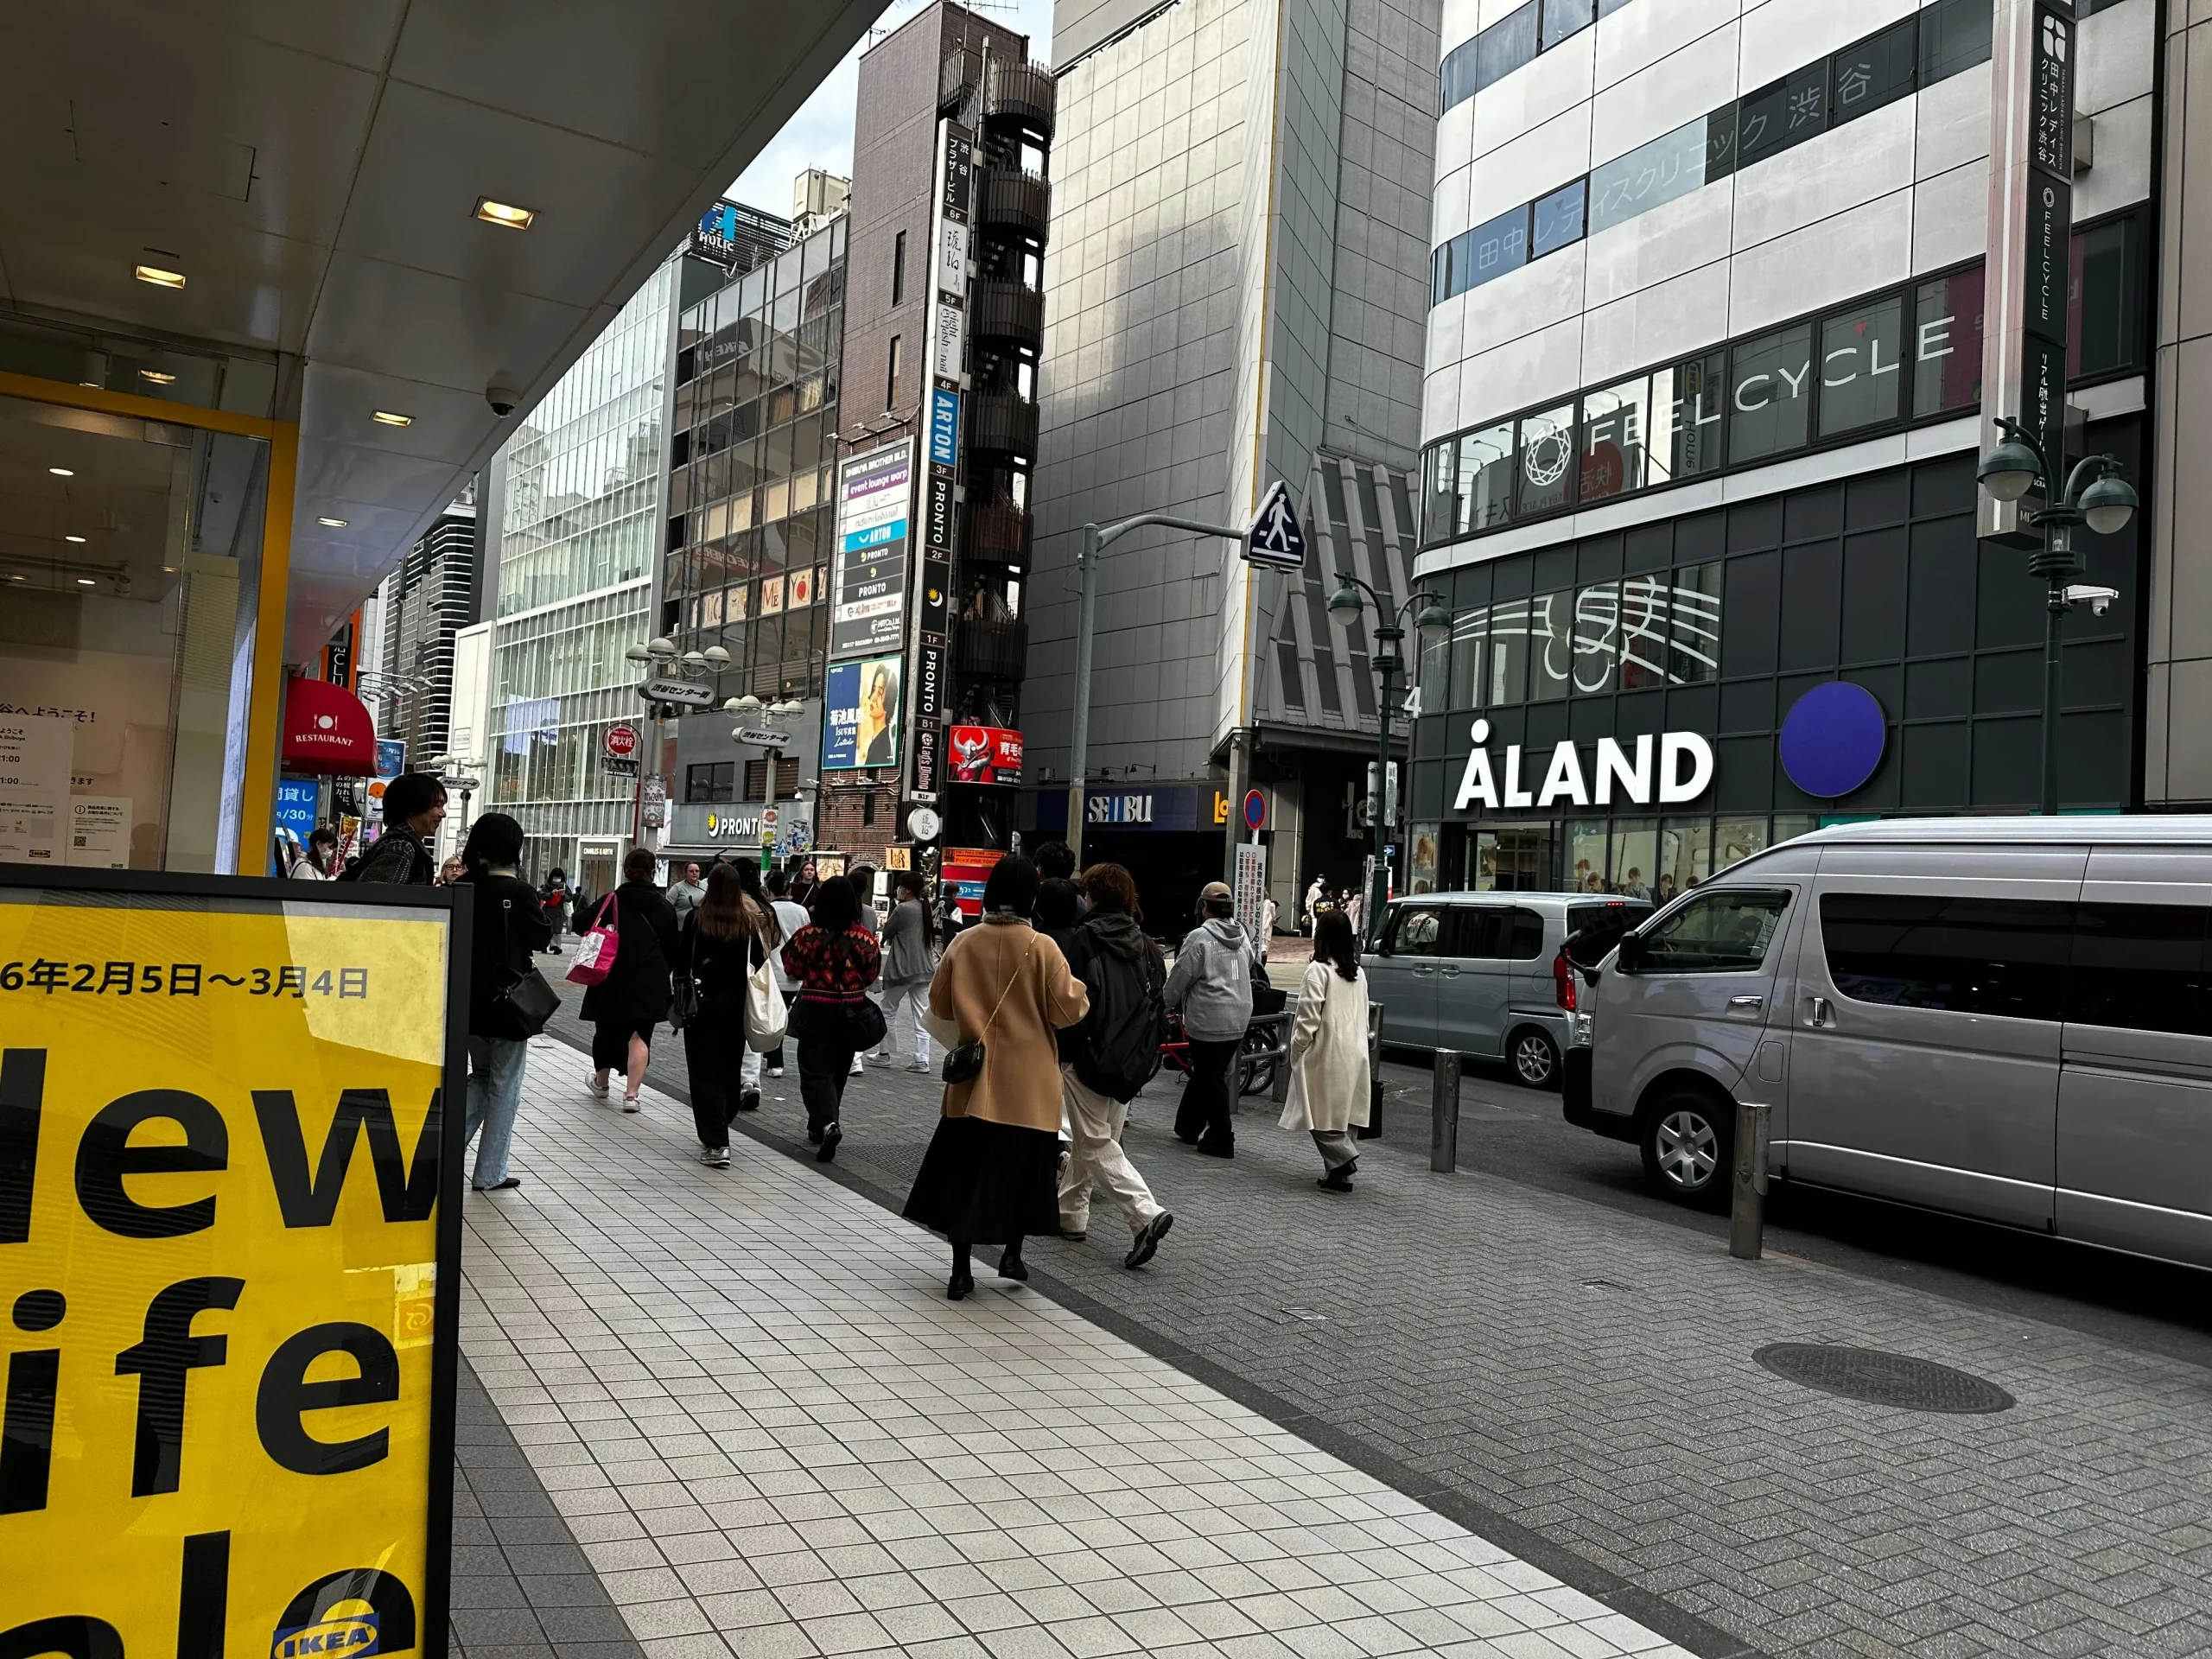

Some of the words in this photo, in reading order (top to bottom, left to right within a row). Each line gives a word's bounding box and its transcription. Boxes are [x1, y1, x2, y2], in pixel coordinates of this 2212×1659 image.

[2038, 58, 2049, 162] クリニック渋谷
[2048, 61, 2059, 167] 田中レディス
[946, 138, 958, 203] ブラザービル
[960, 142, 969, 176] 渋谷
[950, 209, 961, 220] 6F
[699, 232, 734, 252] HULIC
[2042, 211, 2052, 321] FEELCYCLE
[944, 294, 957, 305] 5F
[949, 310, 959, 338] eight
[940, 379, 951, 390] 4F
[1590, 315, 1956, 457] FEELCYCLE
[934, 395, 954, 460] ARTON
[868, 454, 894, 472] BROTHER
[936, 464, 947, 474] 3F
[850, 479, 868, 495] event
[868, 473, 890, 489] lounge
[890, 468, 908, 484] warp
[2033, 480, 2046, 489] SCRA
[933, 480, 946, 543] PRONTO
[869, 525, 892, 543] ARTON
[867, 548, 888, 561] PRONTO
[931, 550, 943, 560] 2F
[858, 582, 887, 598] PRONTO
[927, 634, 938, 645] 1F
[651, 683, 711, 699] 渋谷センター街
[924, 650, 937, 713] PRONTO
[1403, 687, 1422, 719] 4
[922, 719, 933, 729] B1
[296, 734, 354, 747] RESTAURANT
[610, 735, 633, 747] 消火栓
[743, 731, 789, 743] 渋谷センター街
[1453, 718, 1714, 810] ÅLAND
[1089, 795, 1153, 823] SEIBU
[1214, 791, 1229, 823] Lo
[0, 1048, 442, 1244] ew
[283, 1627, 371, 1658] IKEA
